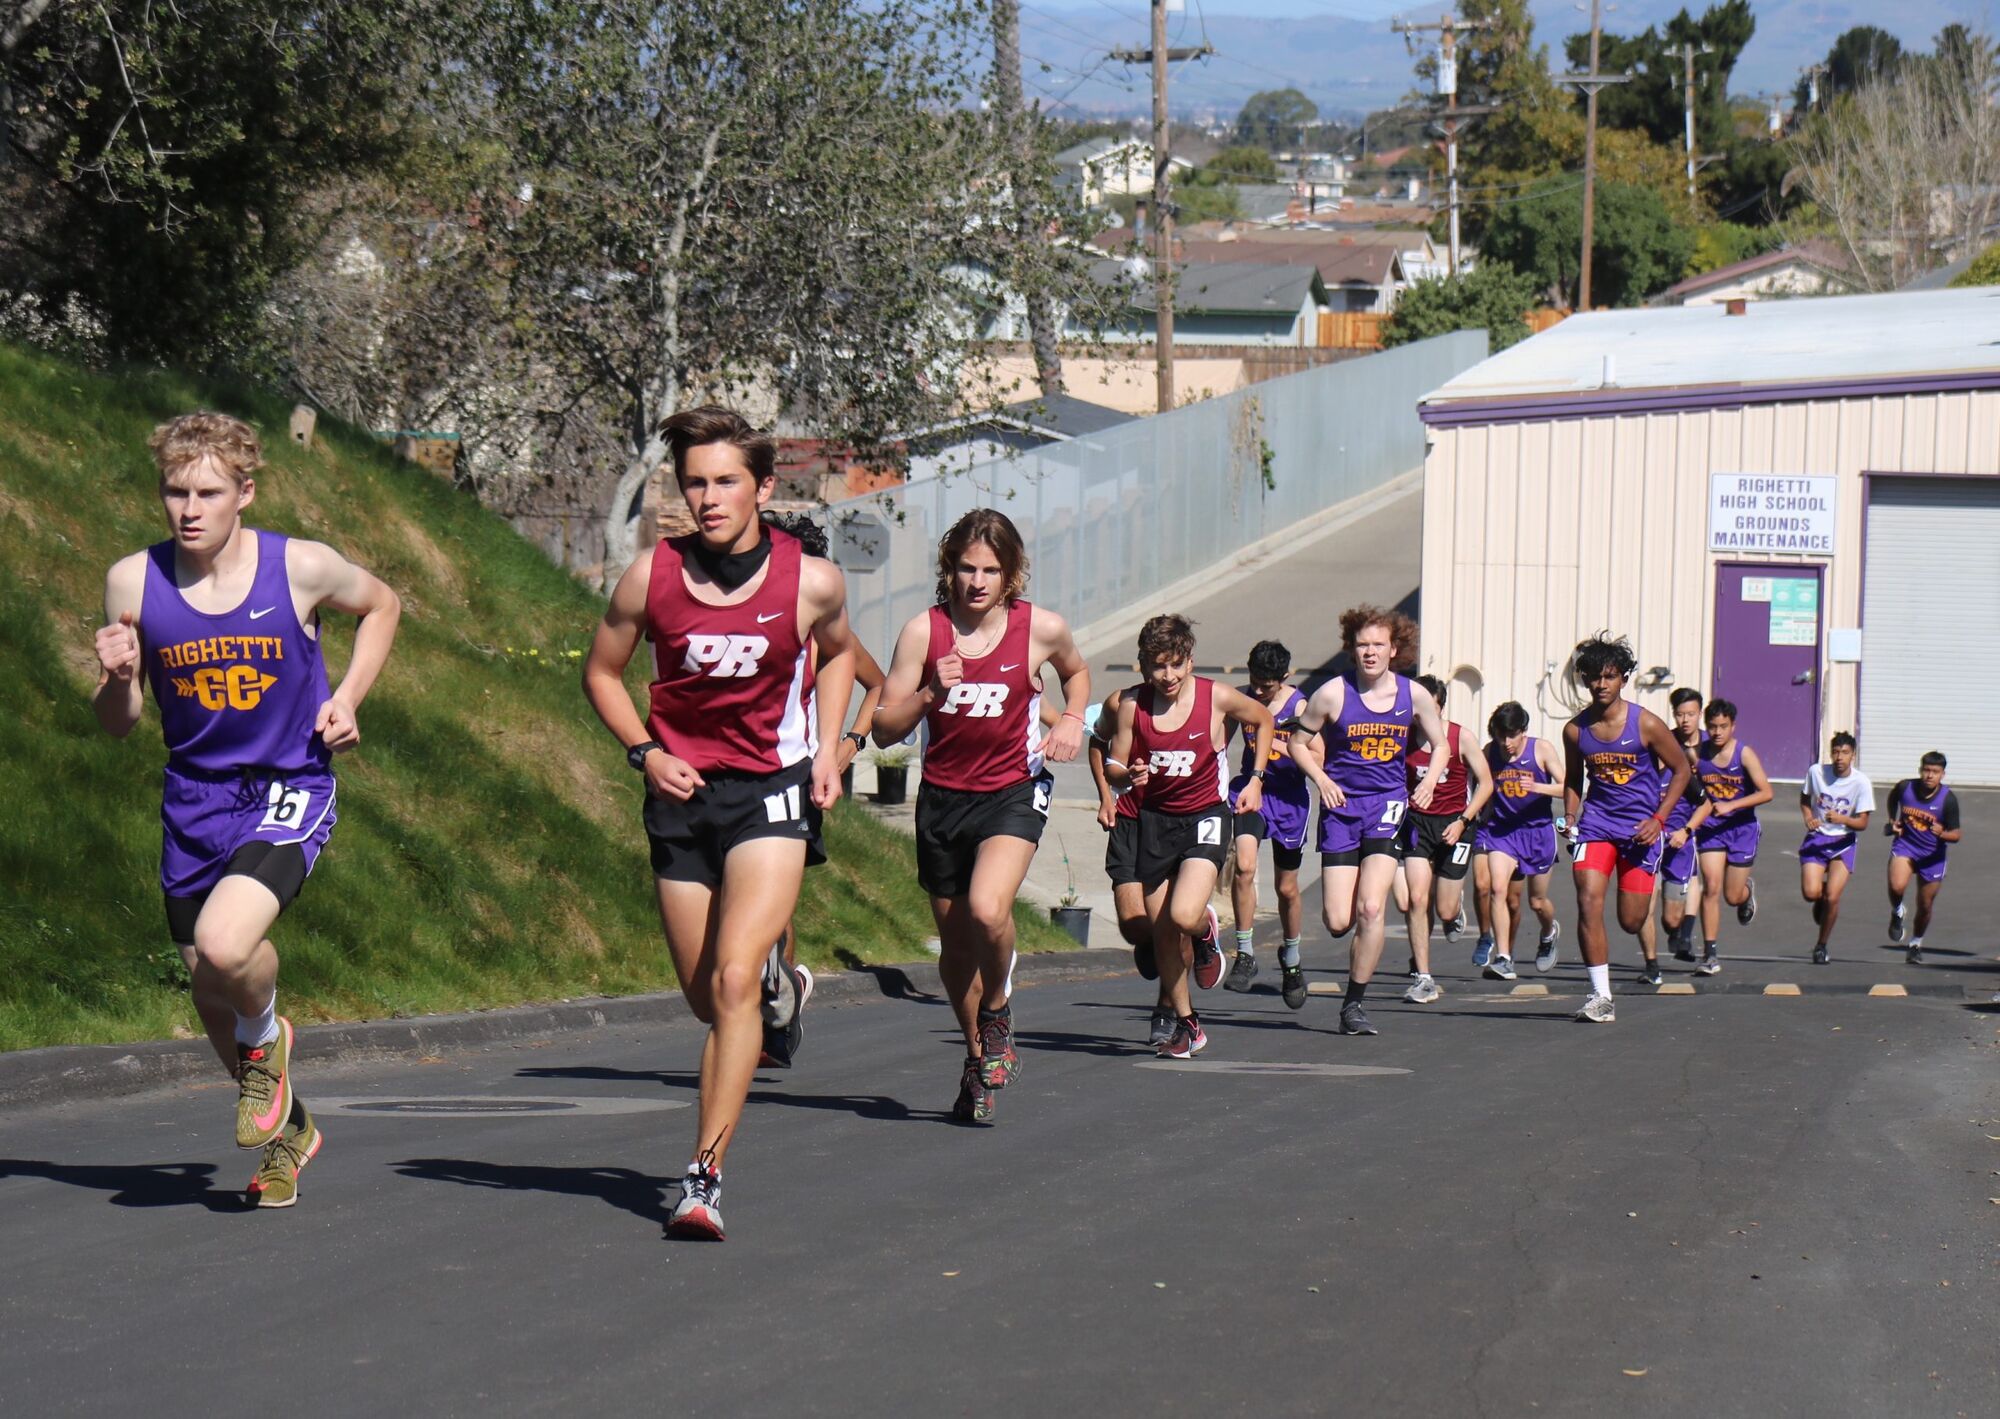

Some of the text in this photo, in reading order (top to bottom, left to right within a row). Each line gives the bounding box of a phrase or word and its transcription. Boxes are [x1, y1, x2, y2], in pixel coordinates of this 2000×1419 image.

[1738, 478, 1811, 494] RIGHETTI
[1720, 495, 1827, 511] HIGH SCHOOL
[1735, 516, 1810, 531] GROUNDS
[1714, 532, 1829, 549] MAINTENANCE
[159, 636, 284, 669] RIGHETTI
[680, 634, 770, 678] PR
[193, 664, 262, 711] CC
[938, 683, 1010, 718] PR
[1346, 722, 1409, 738] RIGHETTI
[1360, 737, 1395, 762] CC
[1148, 750, 1197, 777] PR
[273, 787, 301, 822] 6
[1202, 818, 1217, 843] 2
[1457, 844, 1468, 863] 7
